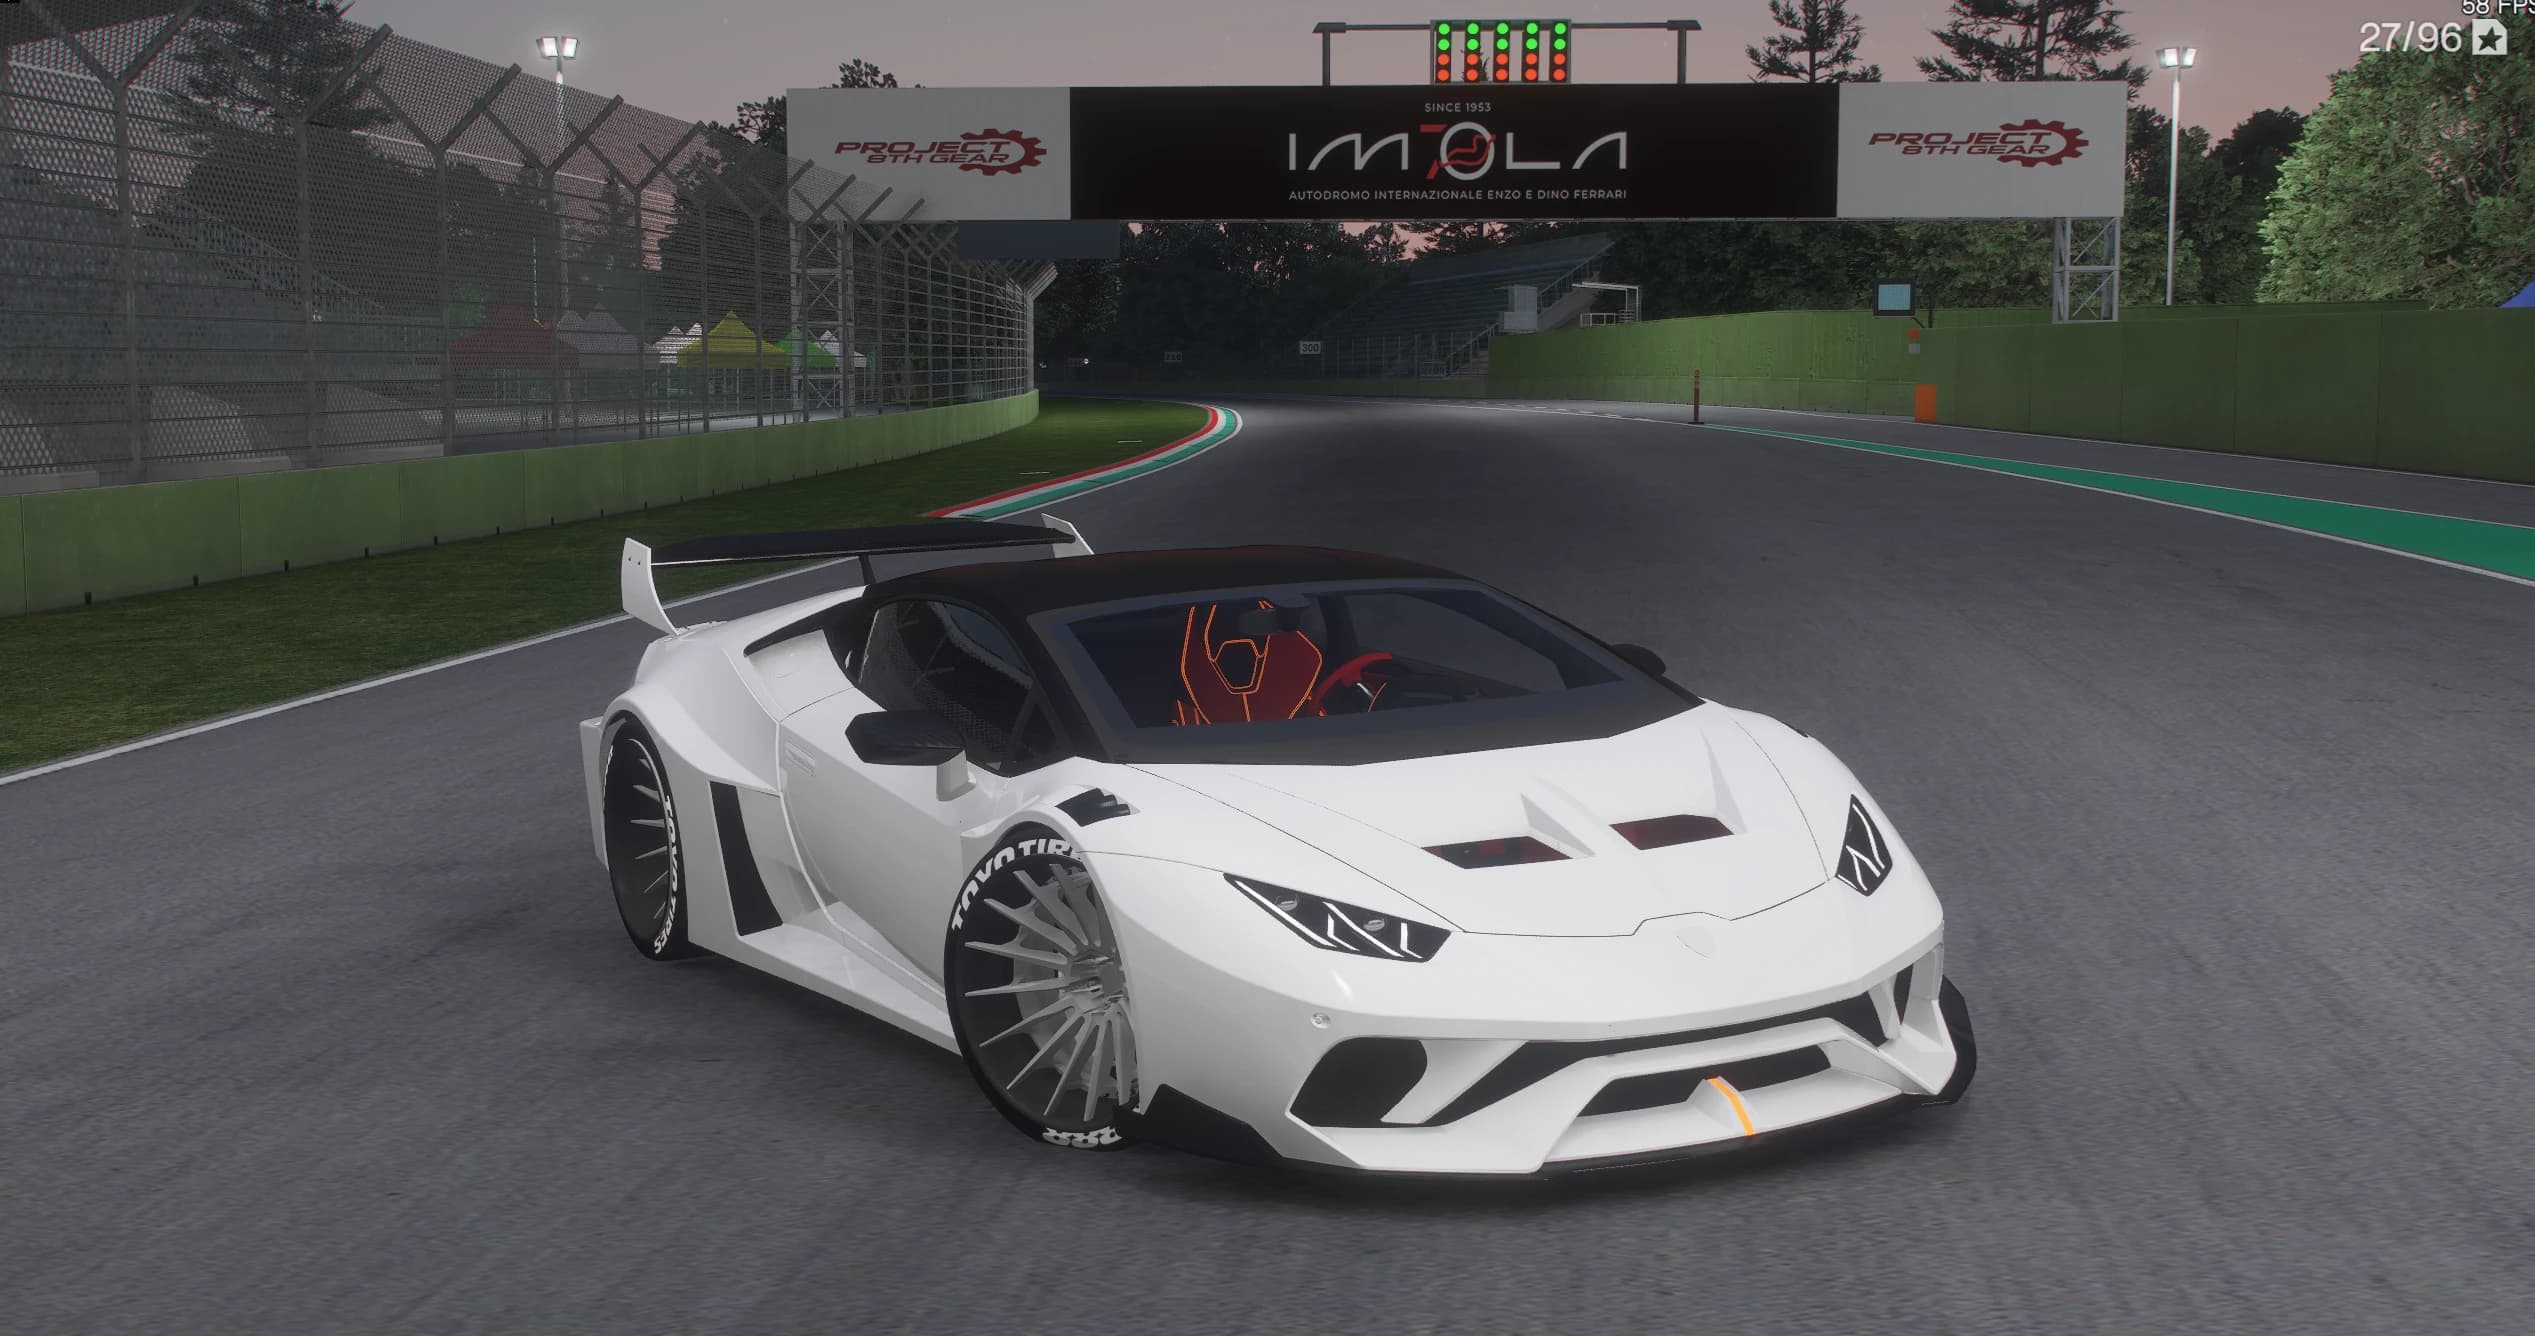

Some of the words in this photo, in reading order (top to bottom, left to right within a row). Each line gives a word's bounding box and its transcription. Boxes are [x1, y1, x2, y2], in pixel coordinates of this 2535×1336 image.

[1424, 102, 1461, 112] SINCE
[1465, 102, 1492, 112] 1953
[1867, 132, 2052, 146] PROJECT
[834, 141, 1011, 154] PROJECT
[1902, 145, 1961, 155] 8TH
[1966, 145, 2051, 155] GEAR
[866, 154, 924, 164] 8TH
[929, 154, 1010, 164] GEAR
[1289, 190, 1370, 200] AUTODROMO
[1374, 189, 1483, 200] INTERNAZIONALE
[1487, 189, 1521, 200] ENZO
[1525, 189, 1533, 200] E
[1537, 189, 1570, 200] DINO
[1573, 189, 1627, 200] FERRARI
[951, 845, 1016, 932] TOYO
[1018, 837, 1082, 861] TIR
